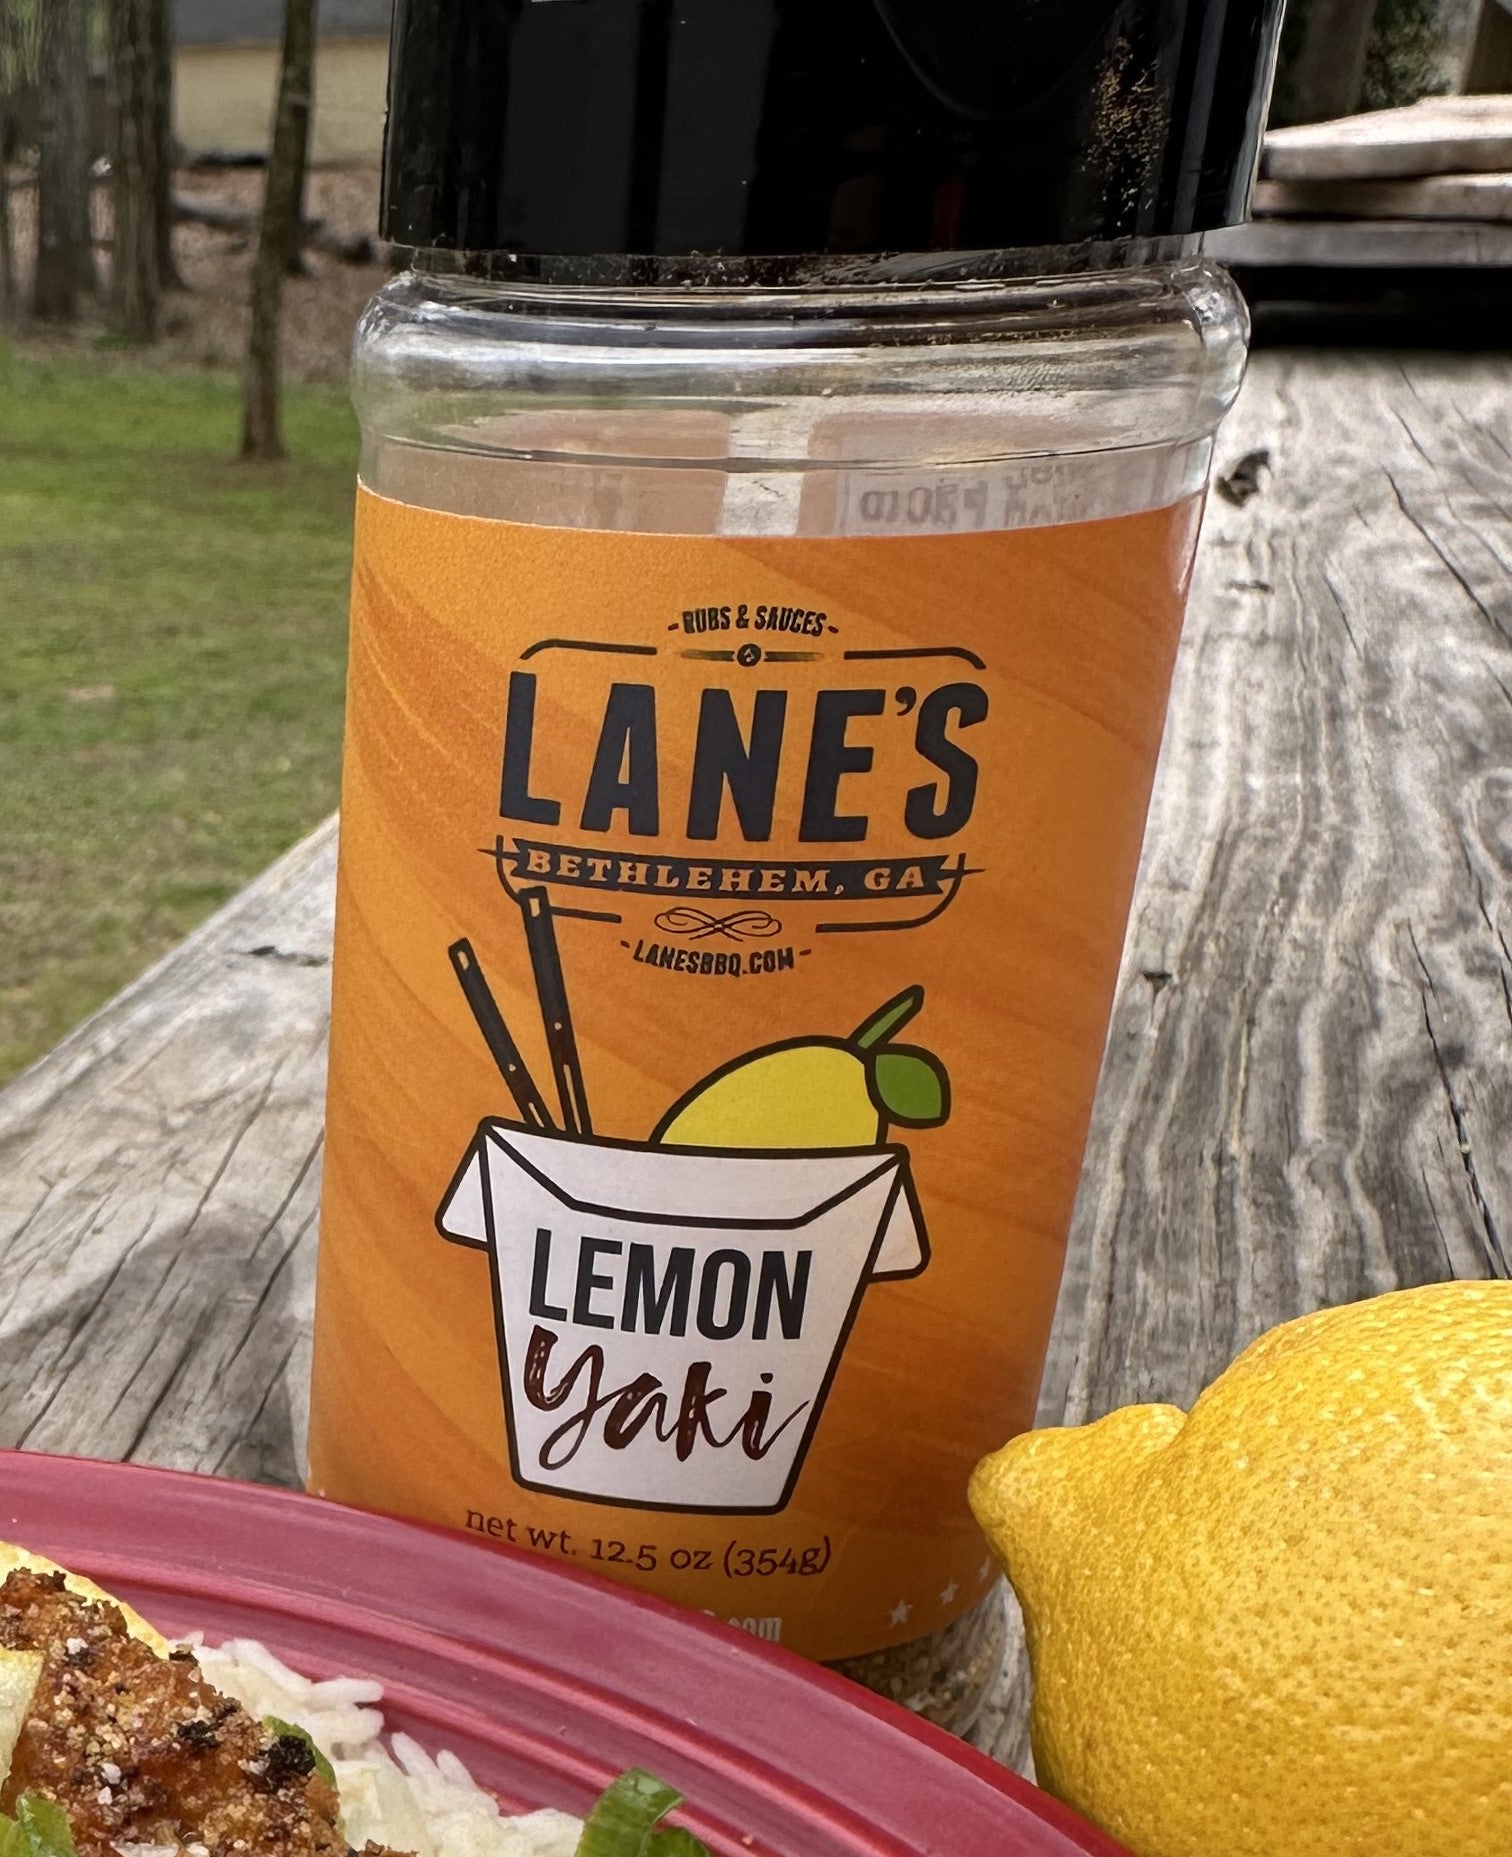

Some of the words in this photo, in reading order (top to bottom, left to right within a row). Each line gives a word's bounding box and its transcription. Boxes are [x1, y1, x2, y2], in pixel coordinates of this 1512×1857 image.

[682, 606, 731, 634] RUBS
[735, 604, 749, 630] &
[754, 605, 827, 637] SAUCES
[499, 671, 989, 843] LANE'S
[526, 848, 845, 896] BETHLEHEM,
[864, 867, 927, 892] GA
[632, 939, 795, 977] LANESBBQ.COM
[529, 1228, 812, 1341] LEMON
[465, 1509, 517, 1543] net
[526, 1527, 577, 1556] wt.
[590, 1538, 657, 1572] 12.5
[670, 1547, 713, 1571] oz
[723, 1535, 831, 1579] (354g)
